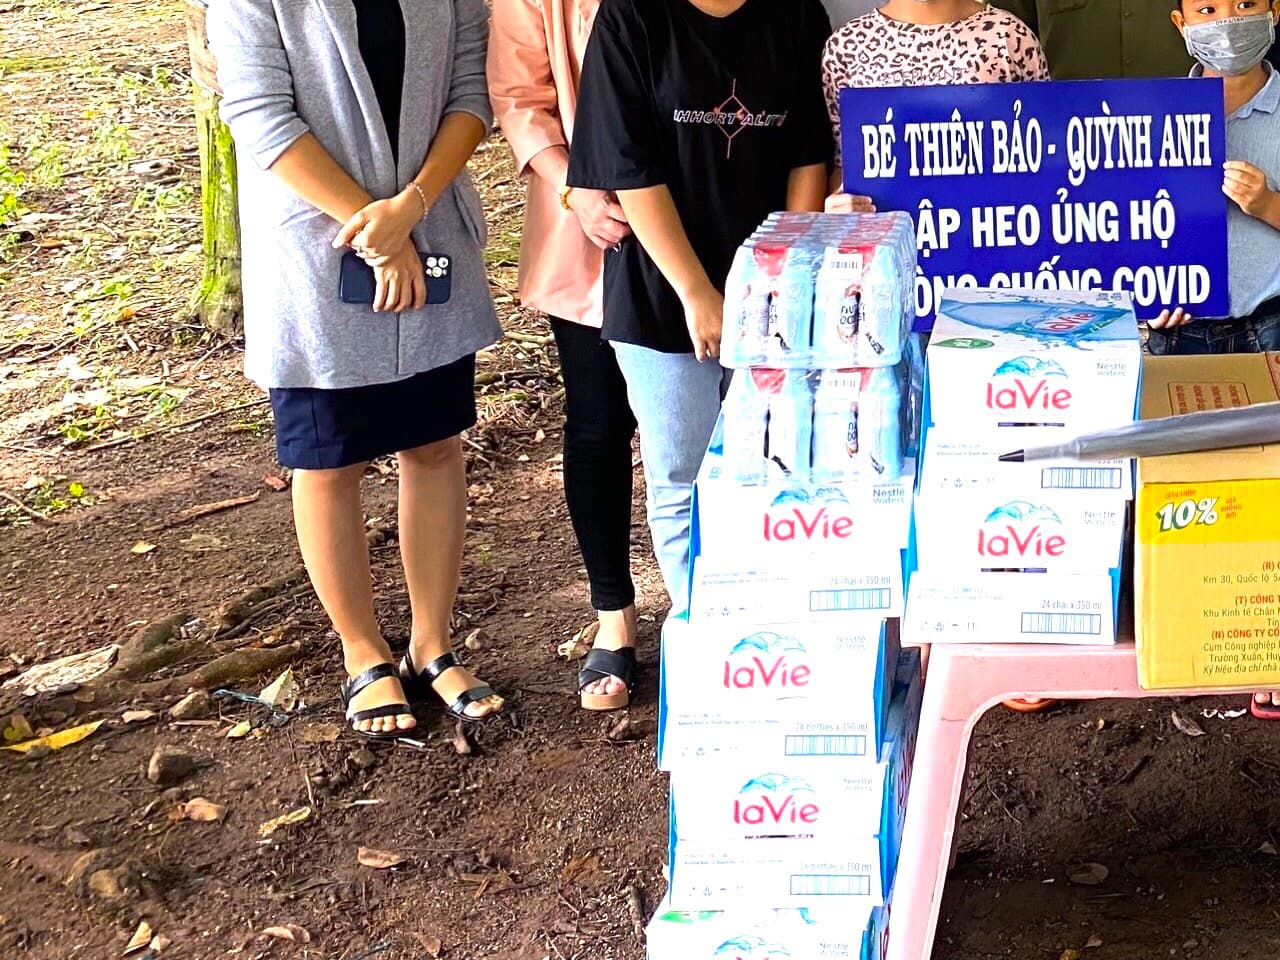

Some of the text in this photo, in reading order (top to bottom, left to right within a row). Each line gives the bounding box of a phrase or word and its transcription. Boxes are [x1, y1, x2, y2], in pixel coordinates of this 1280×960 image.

[862, 107, 897, 178] BÉ
[904, 108, 983, 177] THIÊN
[991, 99, 1042, 174] BẢO
[1067, 101, 1152, 186] QUỲNH
[1159, 113, 1212, 168] ANH
[911, 187, 1176, 258] ẬP HEO ỦNG HỘ
[1113, 264, 1210, 306] COVID
[986, 379, 1072, 409] laVie
[763, 507, 854, 542] laVie
[1155, 496, 1220, 533] 10%
[977, 525, 1066, 557] laVie
[1203, 575, 1217, 584] Km
[1262, 561, 1275, 572] (R)
[1235, 595, 1247, 606] (T)
[1249, 594, 1274, 604] CÔNG
[1211, 630, 1224, 640] (N)
[1227, 628, 1252, 638] CÔNG
[1254, 629, 1266, 638] TY
[723, 655, 811, 689] laVie
[733, 794, 819, 825] laVie
